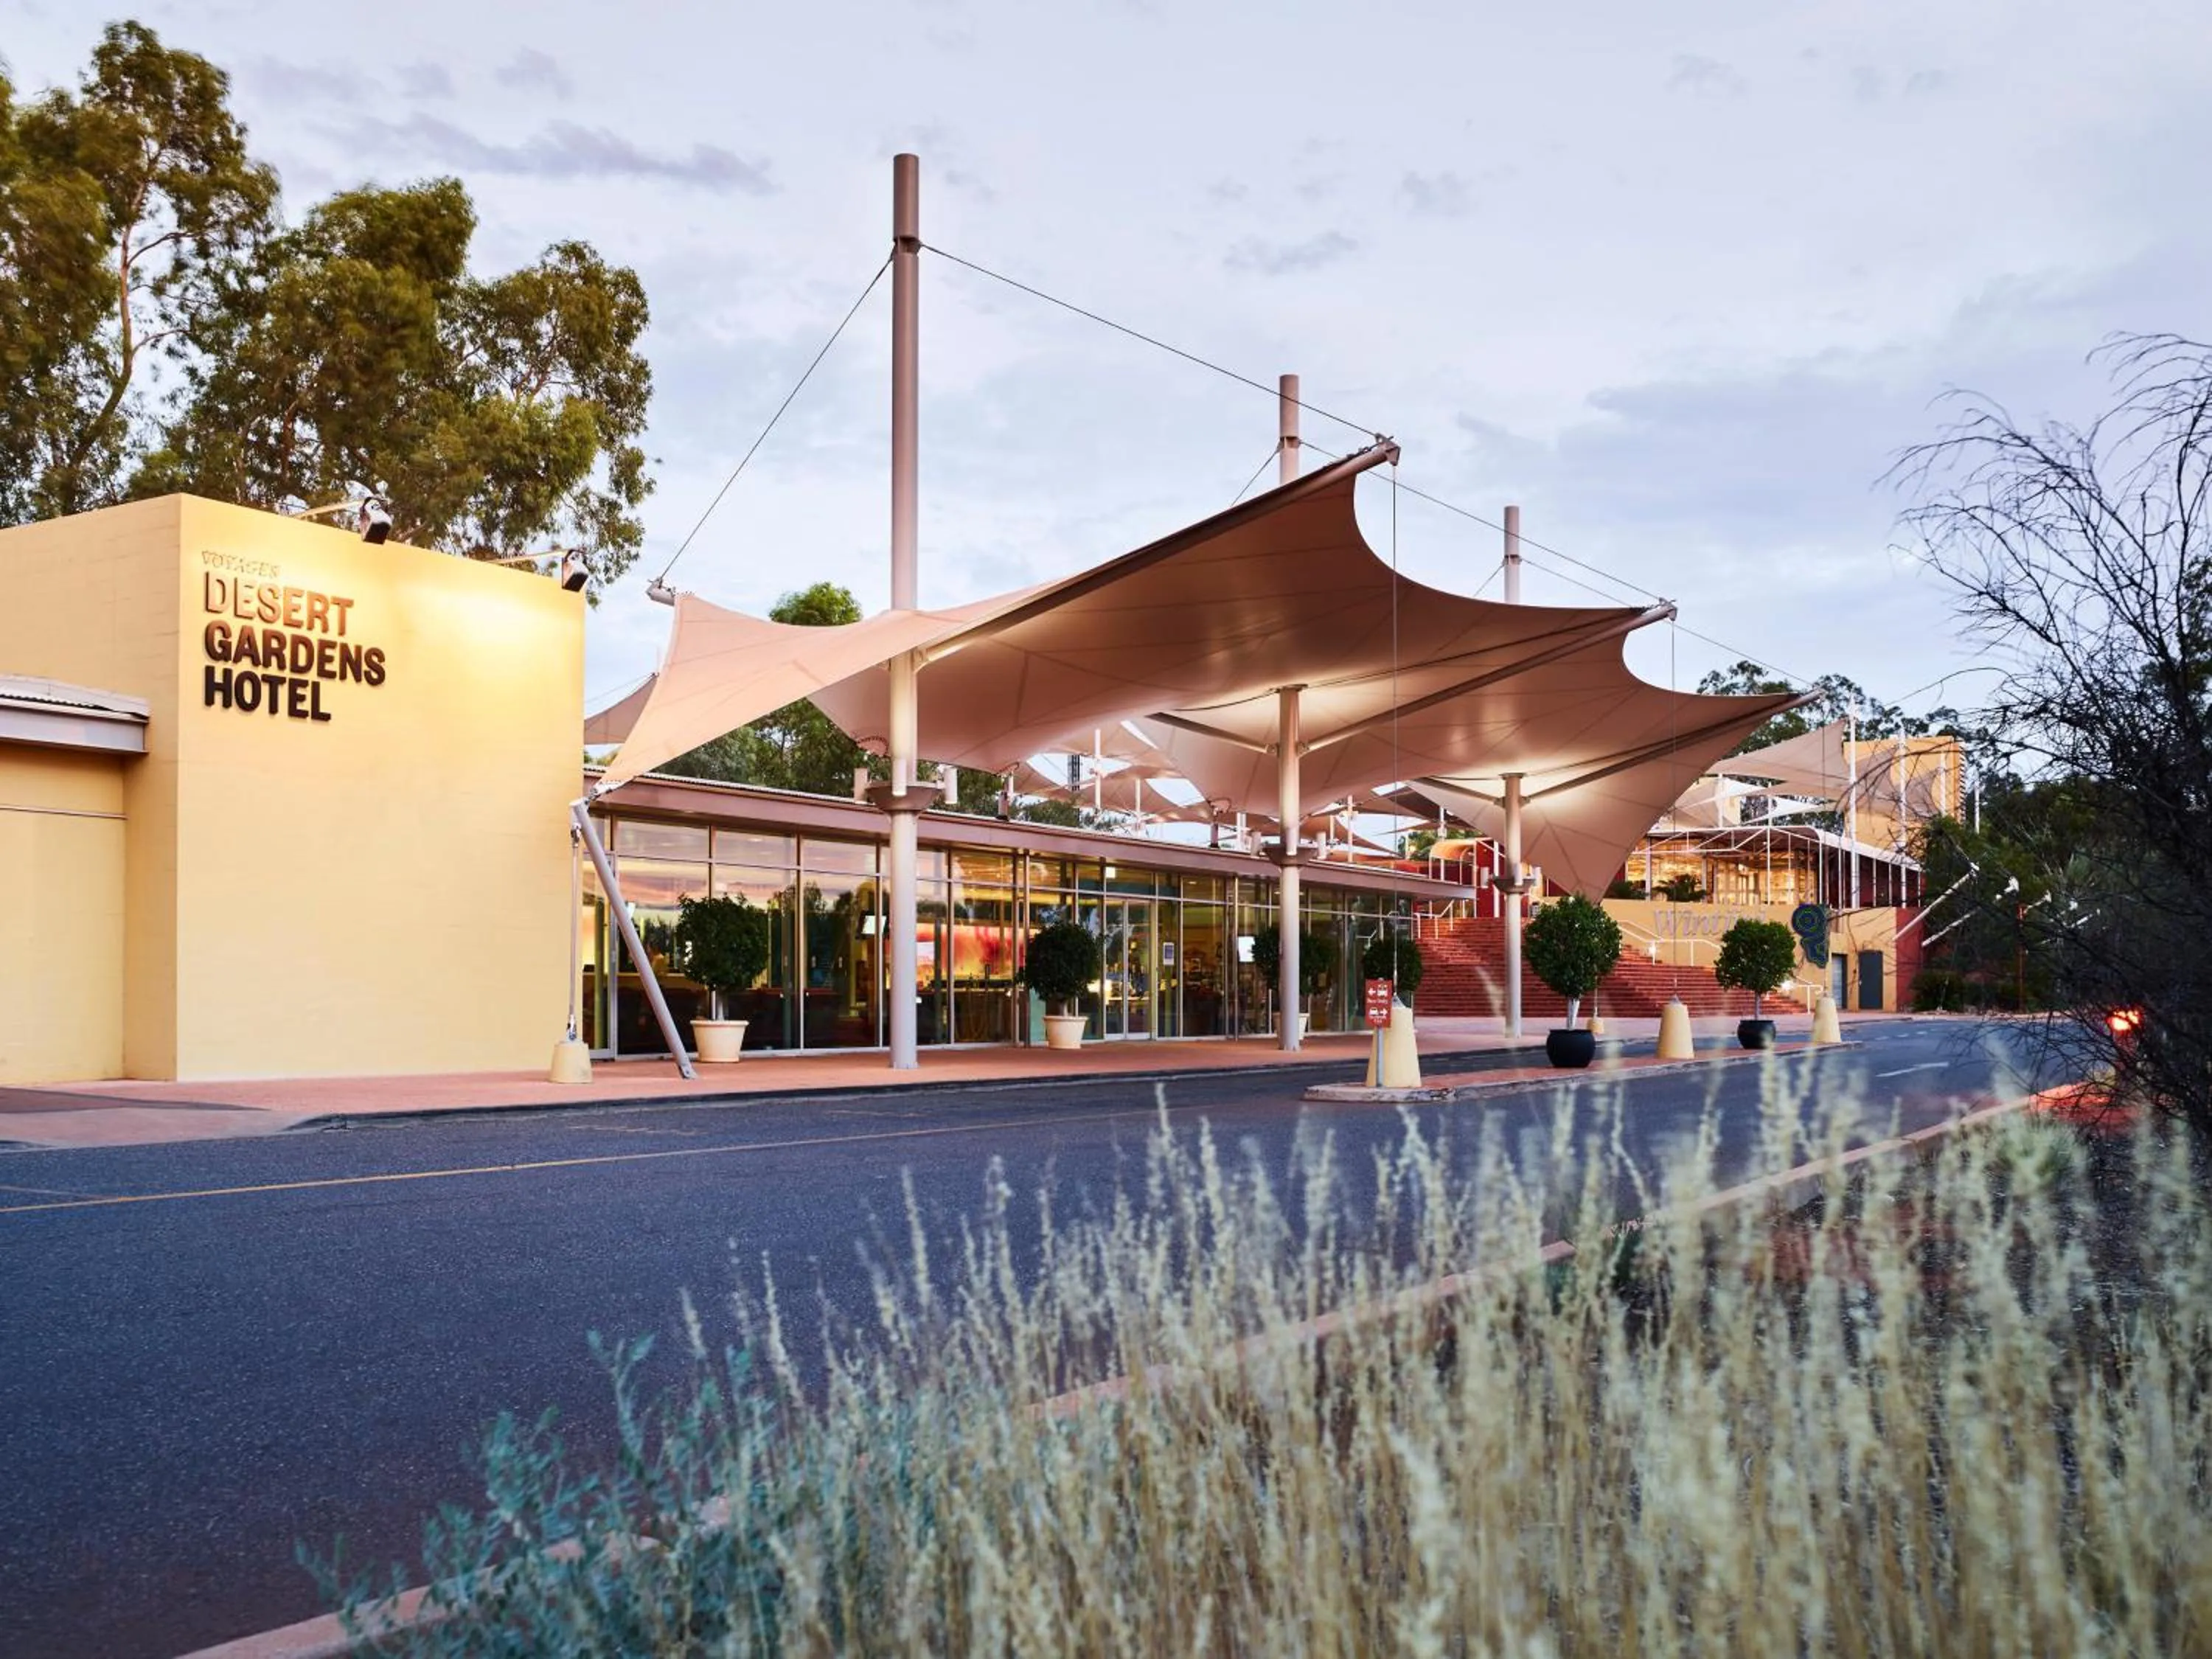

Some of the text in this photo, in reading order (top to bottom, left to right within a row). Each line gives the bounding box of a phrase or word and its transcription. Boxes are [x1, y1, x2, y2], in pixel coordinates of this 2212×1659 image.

[201, 550, 281, 579] VOYAGES
[204, 570, 355, 637] DESERT
[204, 619, 386, 686] GARDENS
[204, 664, 332, 722] HOTEL
